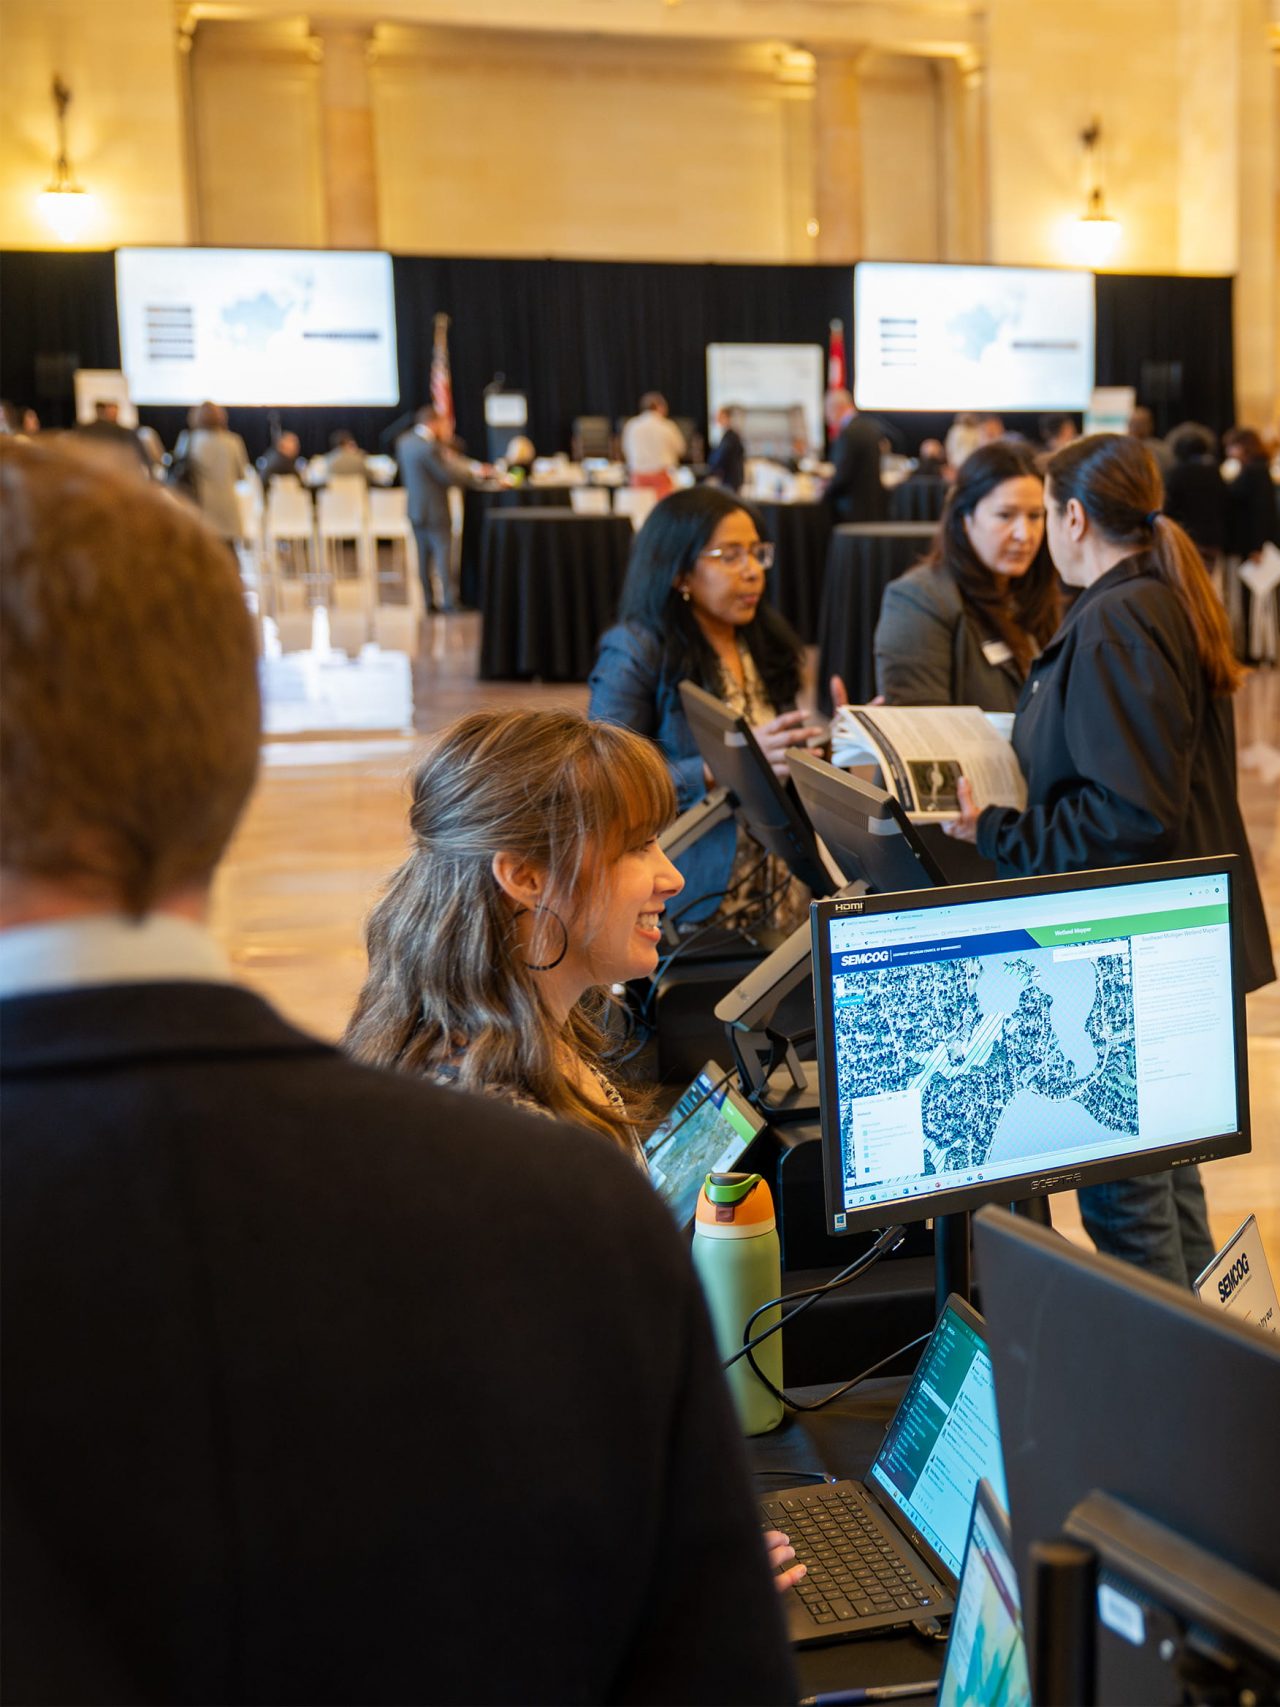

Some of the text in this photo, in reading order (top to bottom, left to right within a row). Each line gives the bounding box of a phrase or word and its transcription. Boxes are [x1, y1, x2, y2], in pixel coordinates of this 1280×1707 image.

[834, 902, 863, 911] HDMI
[1055, 926, 1092, 936] Wetland Mapper
[841, 950, 889, 966] SEMCOG
[1031, 1172, 1082, 1190] SCEPTRE
[1218, 1253, 1250, 1303] SEMCOG
